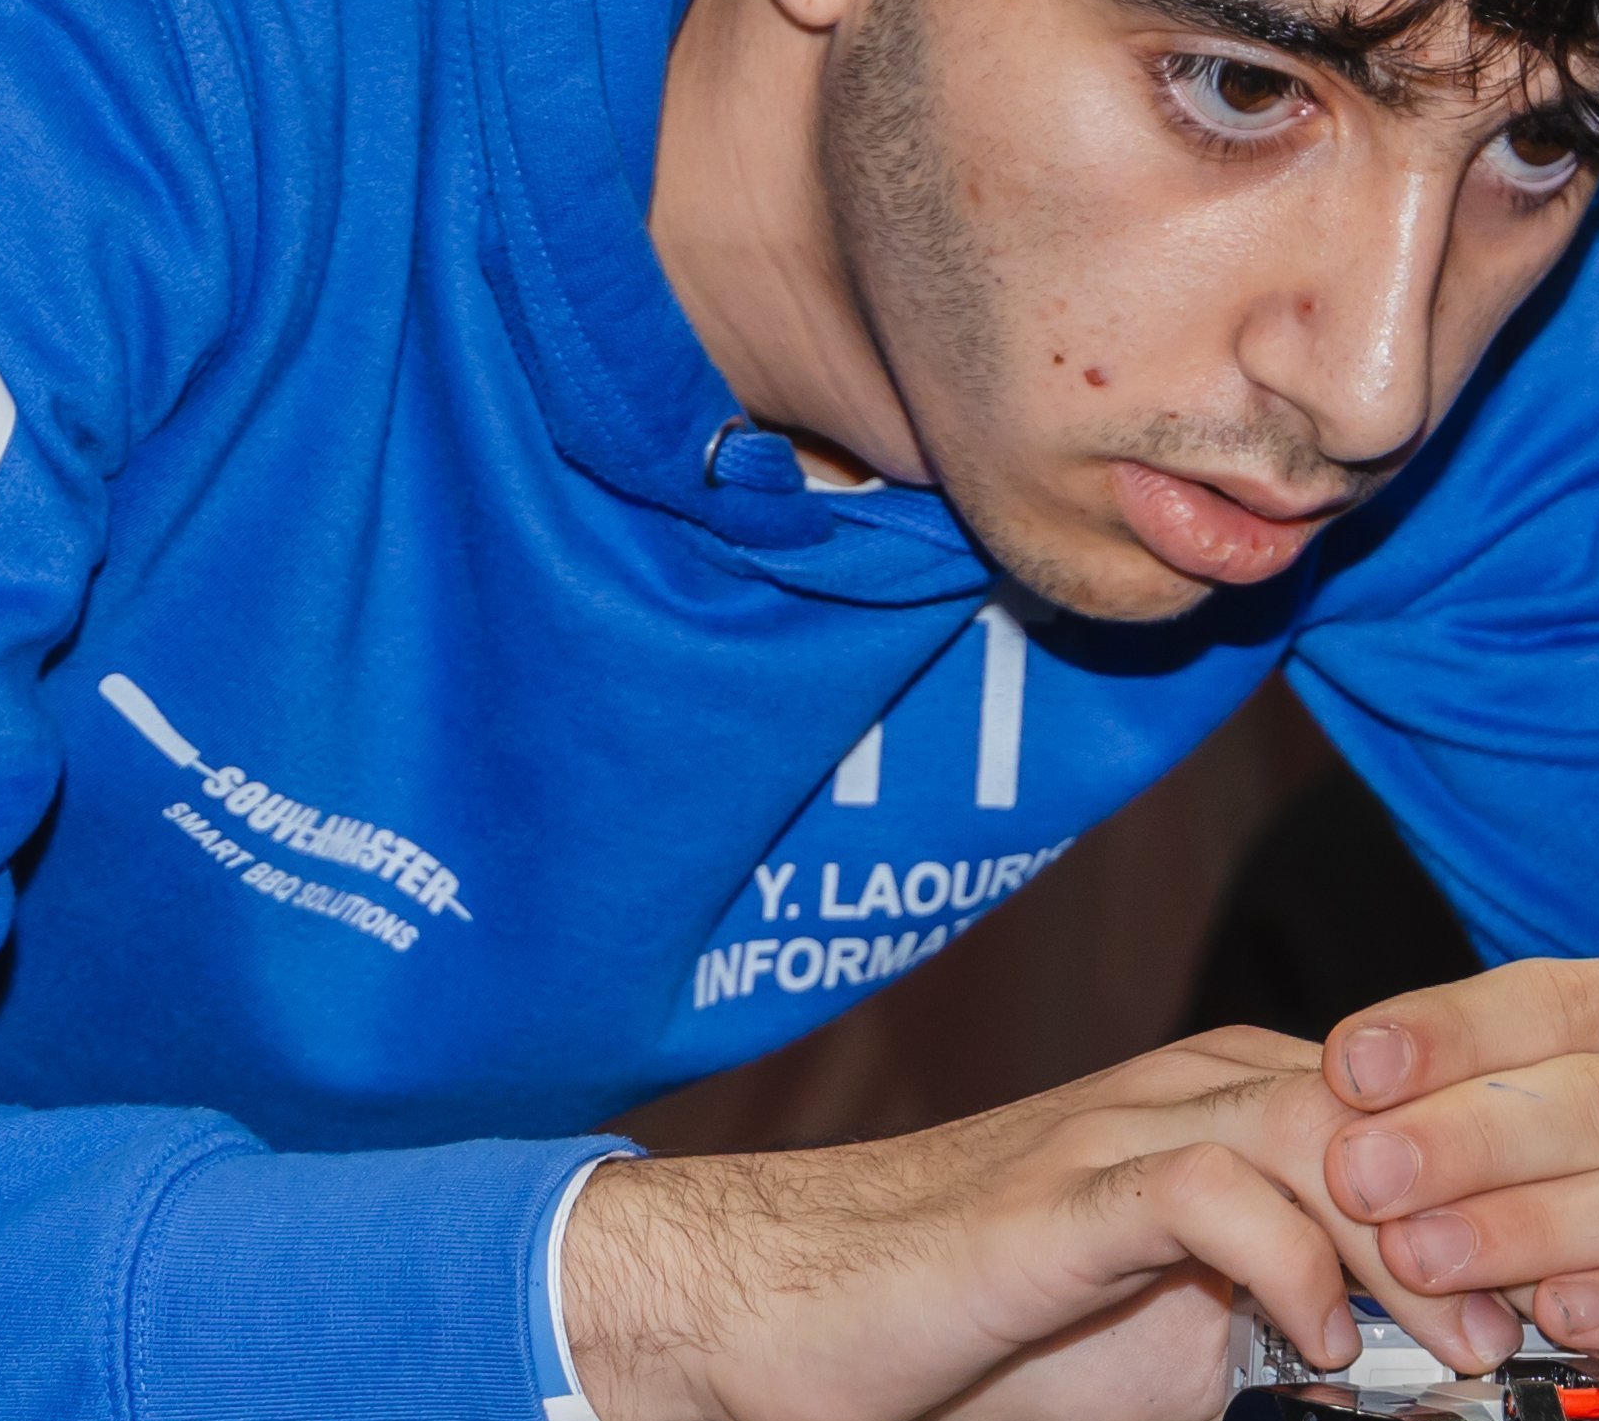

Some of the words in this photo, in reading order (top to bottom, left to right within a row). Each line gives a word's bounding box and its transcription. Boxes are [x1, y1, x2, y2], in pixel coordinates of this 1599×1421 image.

[162, 802, 255, 869] SMART
[241, 861, 301, 904] BBQ
[291, 881, 420, 953] SOLUTIONS
[754, 861, 801, 921] Y.
